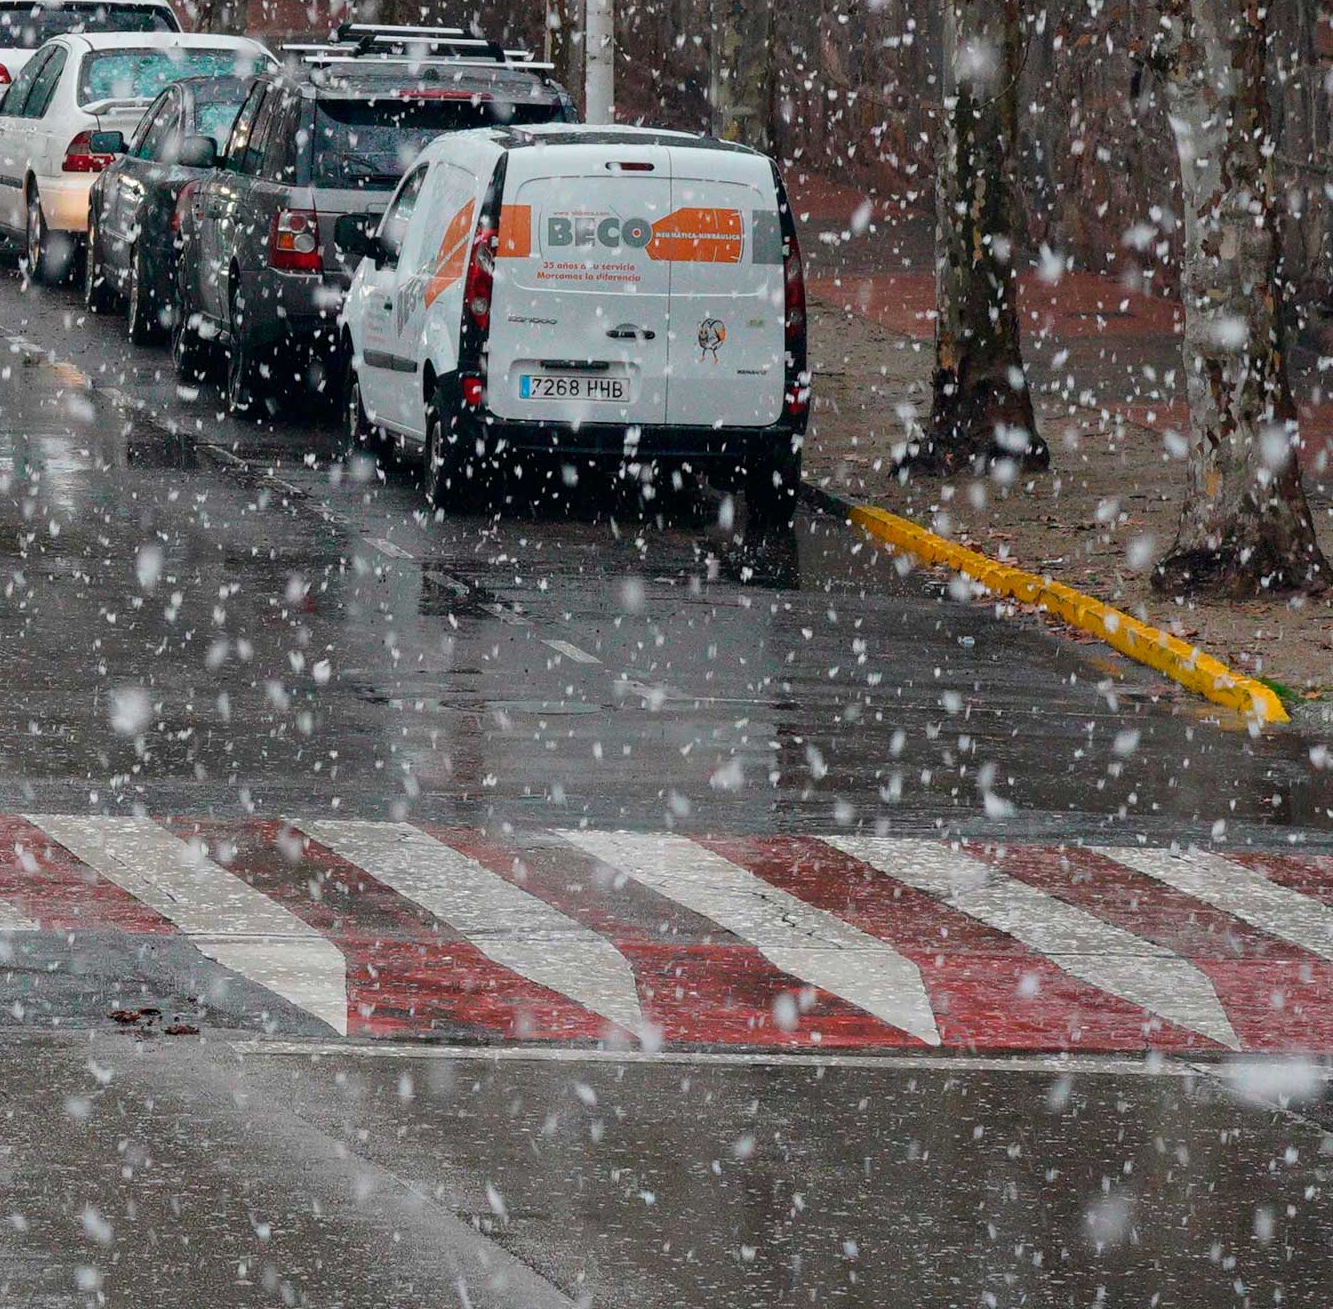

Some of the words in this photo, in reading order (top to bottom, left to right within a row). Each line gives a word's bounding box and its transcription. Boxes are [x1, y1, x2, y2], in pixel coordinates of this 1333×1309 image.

[547, 217, 654, 248] BECO
[542, 260, 554, 270] 35
[556, 261, 579, 270] años
[600, 262, 637, 272] servicio
[536, 270, 583, 280] Marcamos
[584, 272, 595, 281] la
[595, 272, 642, 283] diferencia
[532, 377, 580, 397] 7268
[587, 379, 625, 398] HHB
